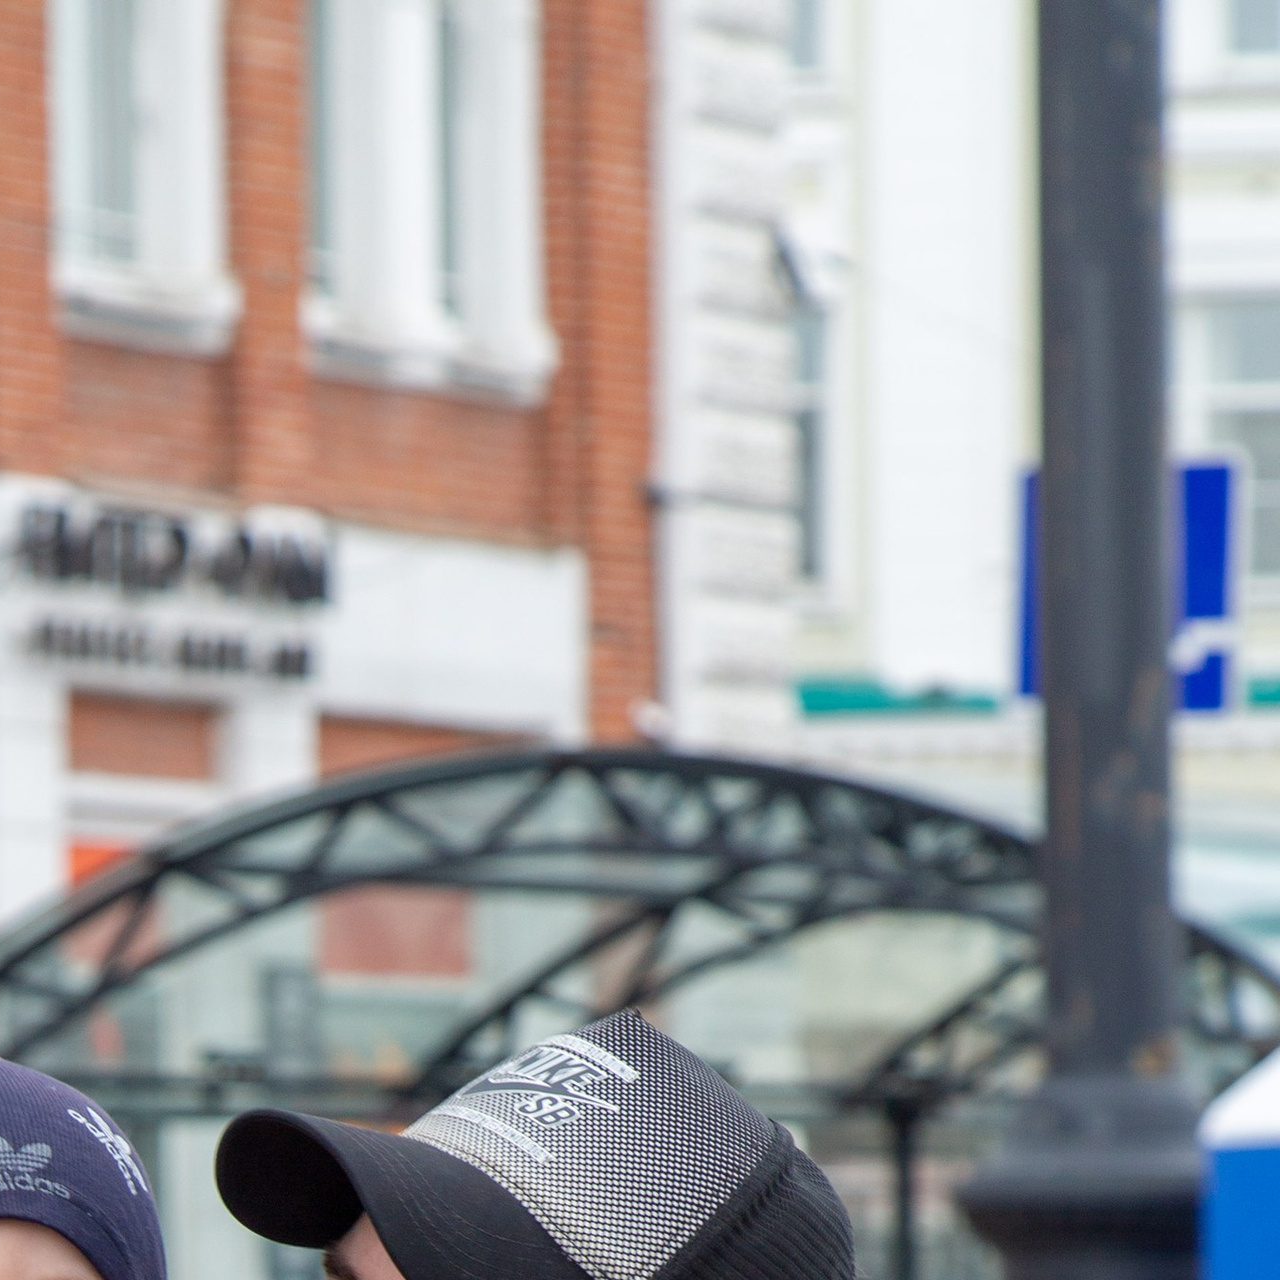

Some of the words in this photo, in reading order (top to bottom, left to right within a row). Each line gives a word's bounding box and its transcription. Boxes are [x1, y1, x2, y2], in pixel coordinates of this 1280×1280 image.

[513, 1047, 606, 1091] NIKE
[517, 1094, 578, 1127] SB
[66, 1107, 138, 1196] adidas
